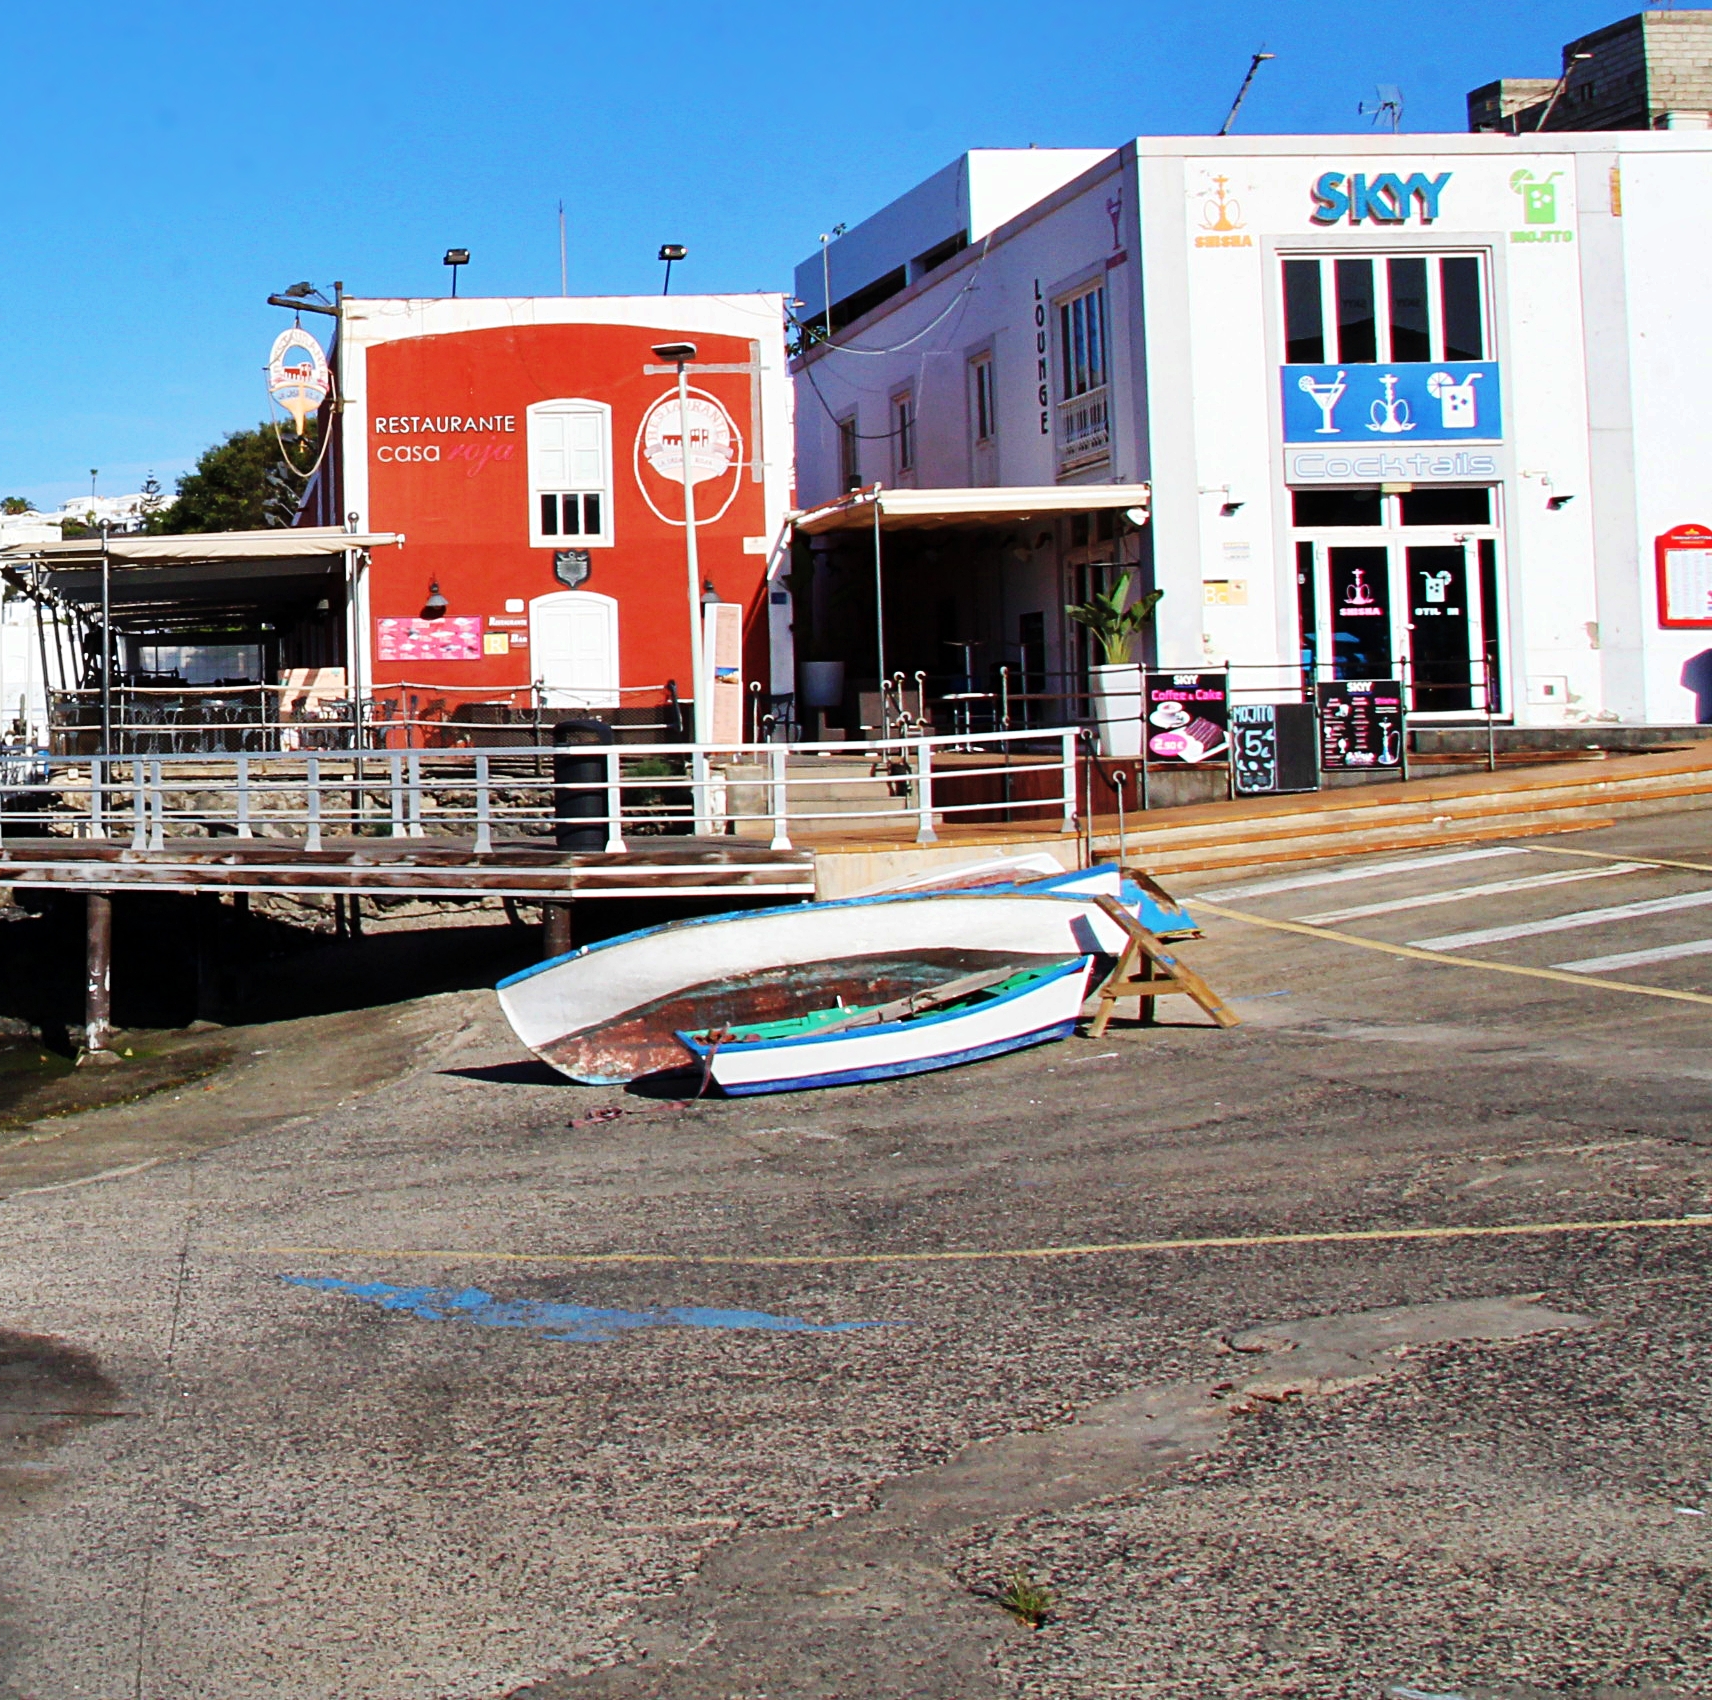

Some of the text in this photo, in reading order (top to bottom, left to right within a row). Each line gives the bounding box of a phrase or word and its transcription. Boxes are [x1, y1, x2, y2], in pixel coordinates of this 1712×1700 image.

[1309, 171, 1453, 226] SKYY
[1194, 235, 1253, 248] SHISHA
[1509, 230, 1573, 243] MOJITO
[1034, 278, 1048, 435] LOUNGE
[375, 415, 515, 434] RESTAURANTE
[376, 435, 515, 478] casa roja
[1294, 452, 1496, 478] Cocktails
[1339, 607, 1383, 616] SHISHA
[490, 636, 505, 652] R
[1173, 674, 1199, 686] SKYY
[1346, 681, 1373, 693] SKYY
[1151, 689, 1188, 701] Coffee
[1195, 689, 1225, 701] Cake
[1233, 704, 1275, 723] MOJITO
